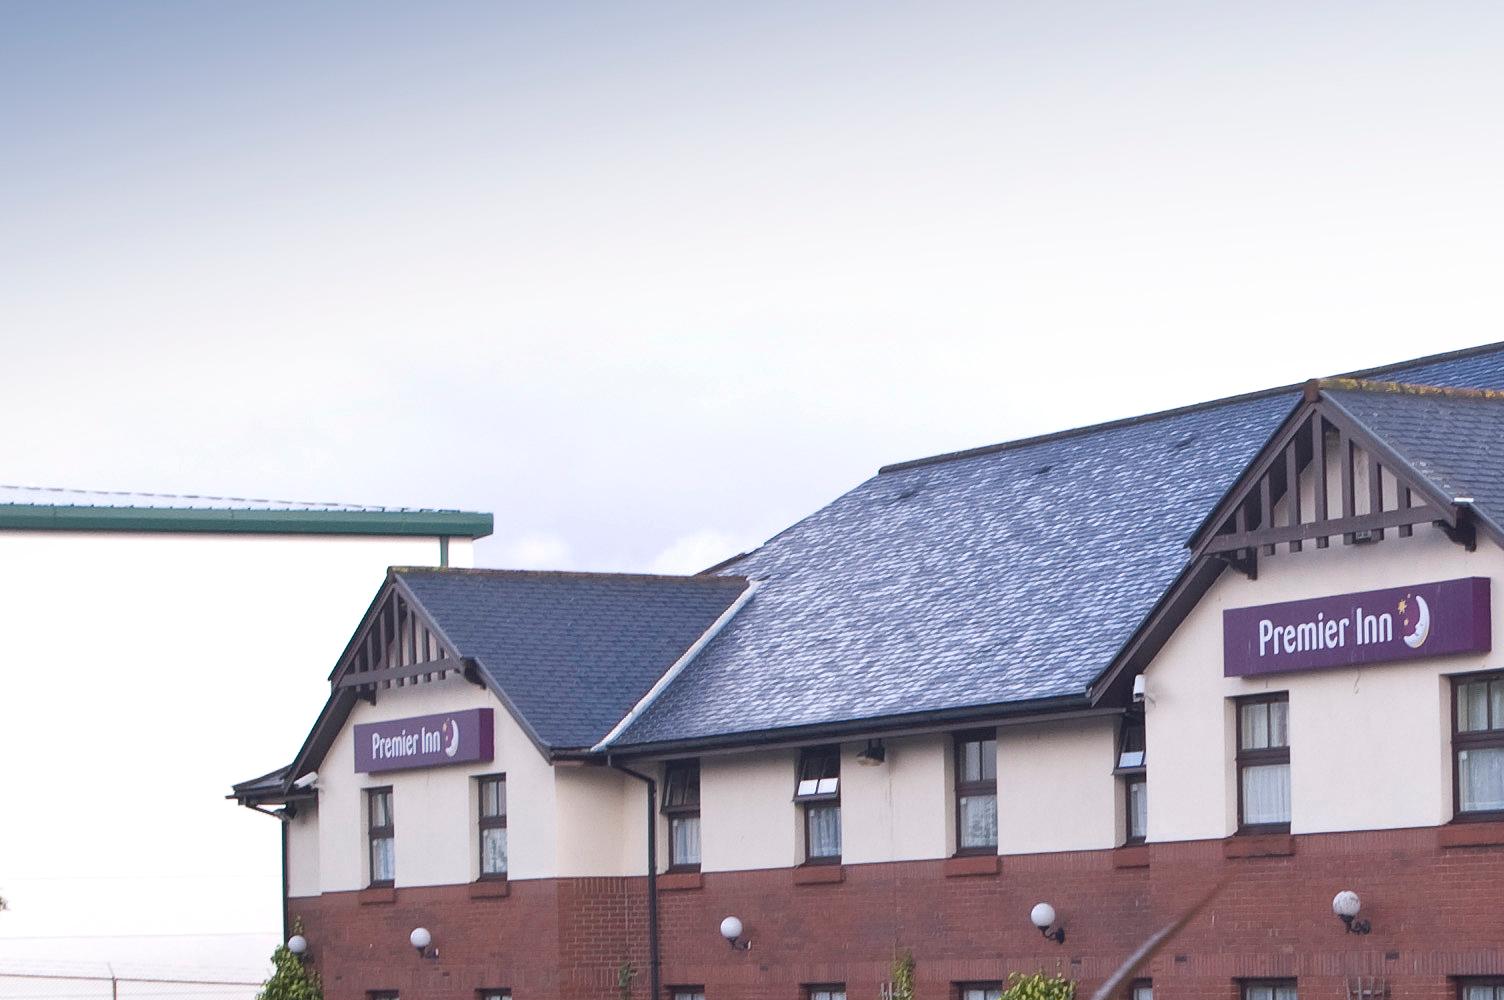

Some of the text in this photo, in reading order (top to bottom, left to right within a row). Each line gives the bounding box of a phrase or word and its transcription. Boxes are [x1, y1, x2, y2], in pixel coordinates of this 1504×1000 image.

[1258, 607, 1393, 657] Premier Inn
[371, 726, 441, 760] Premier Inn
